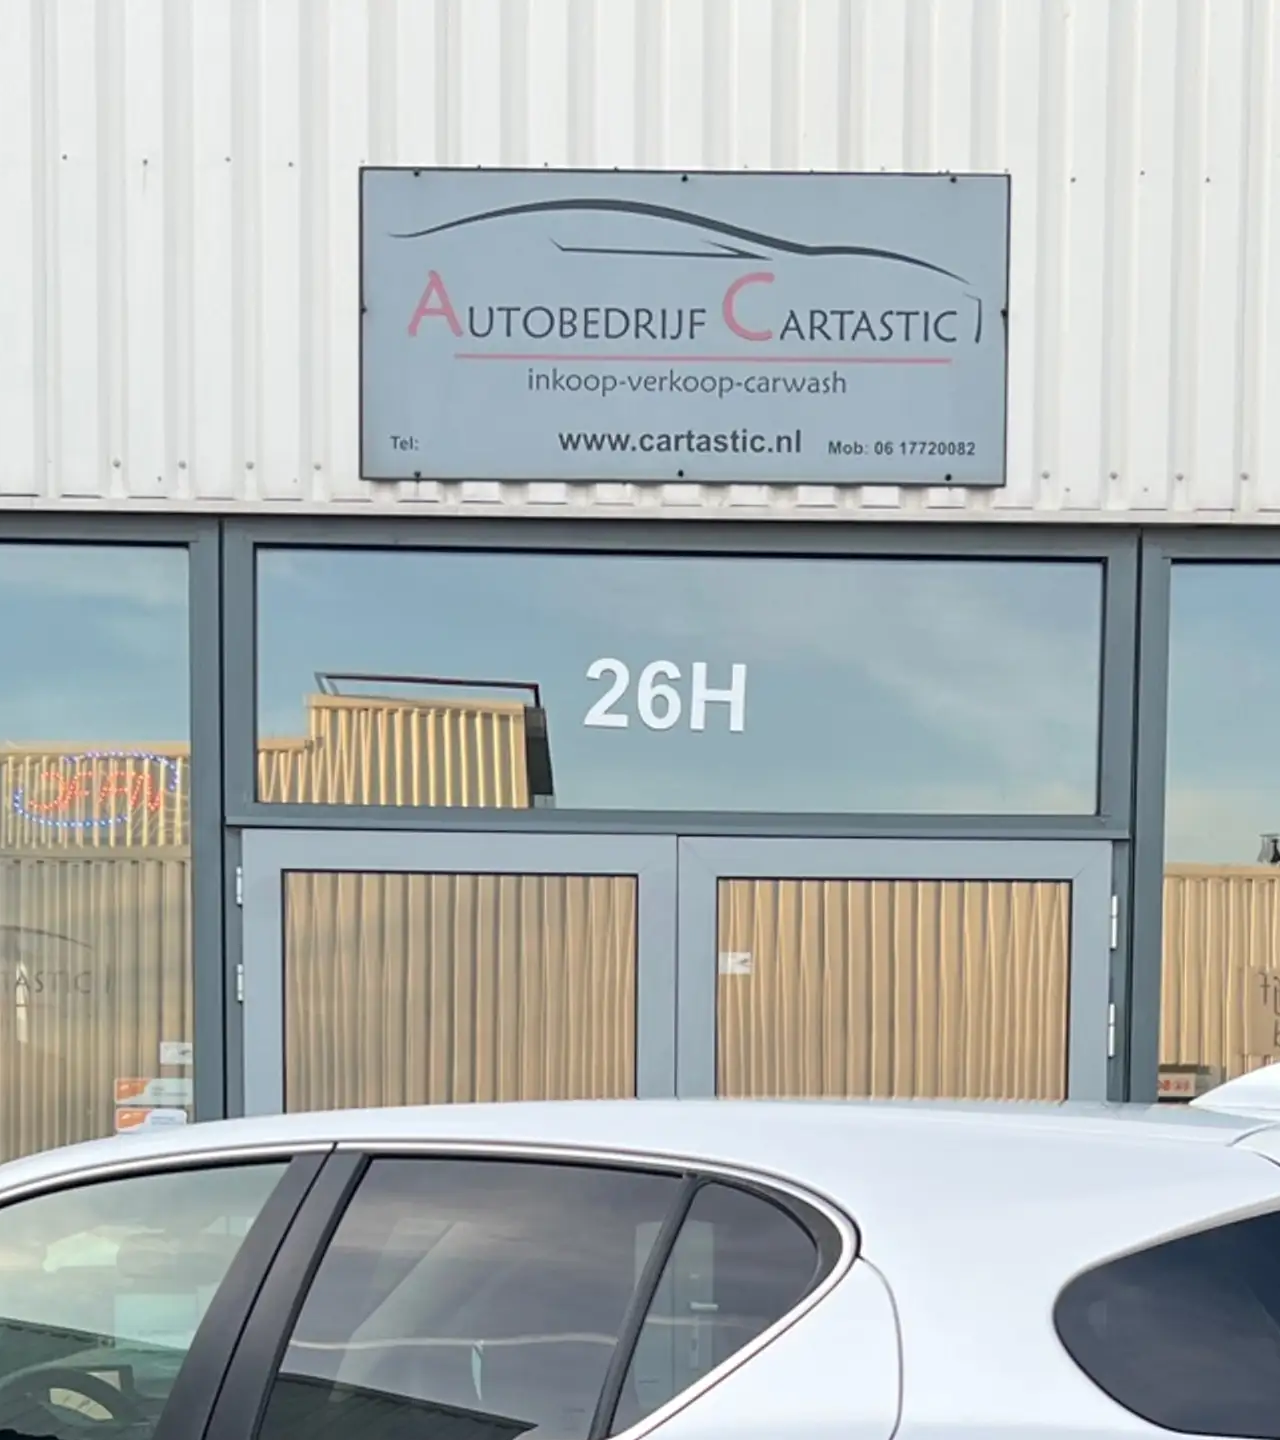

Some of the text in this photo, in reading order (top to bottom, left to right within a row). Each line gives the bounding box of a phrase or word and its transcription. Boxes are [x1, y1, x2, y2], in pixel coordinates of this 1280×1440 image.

[527, 367, 847, 397] inkoop-verkoop-carwash
[390, 434, 419, 452] Tel:
[558, 428, 802, 454] www.cartastic.nl
[828, 438, 976, 456] Mob: 06 17720082
[583, 657, 748, 733] 26H
